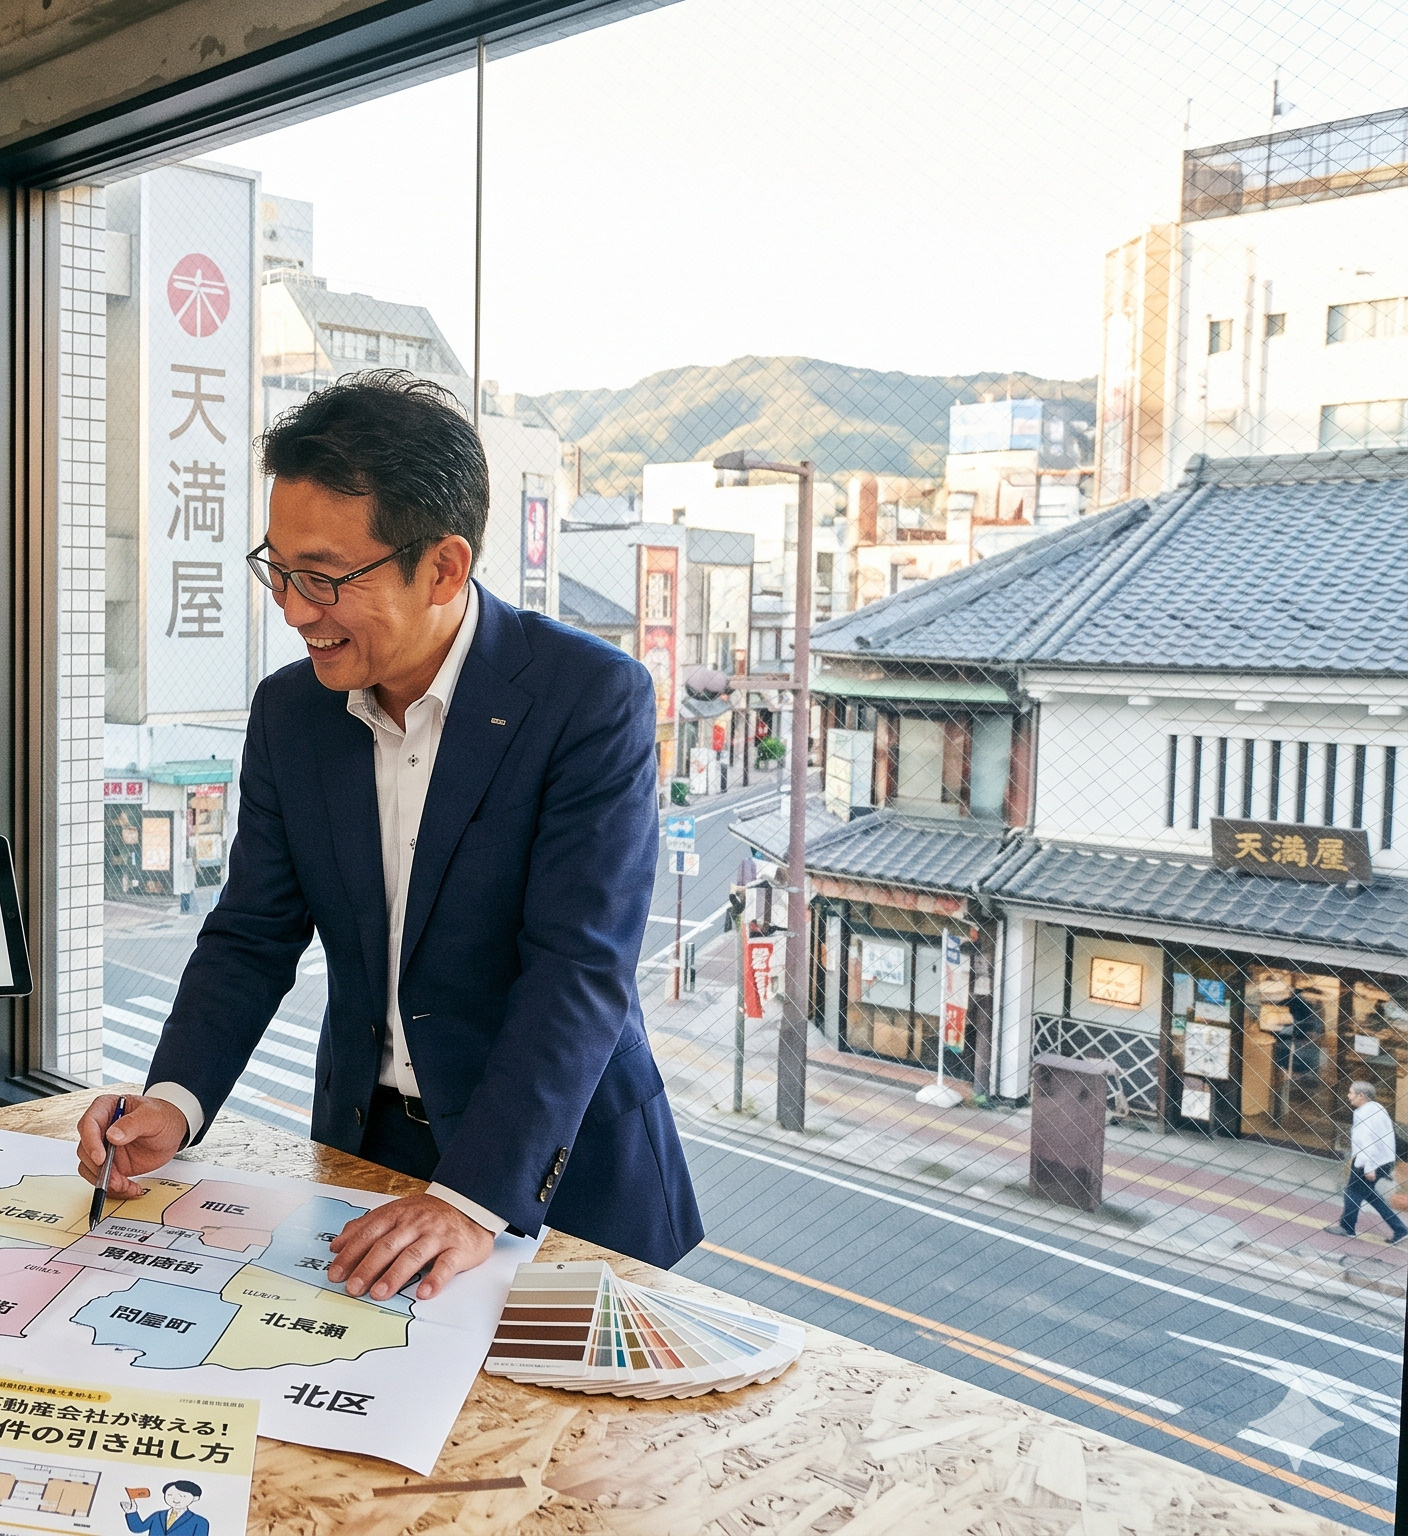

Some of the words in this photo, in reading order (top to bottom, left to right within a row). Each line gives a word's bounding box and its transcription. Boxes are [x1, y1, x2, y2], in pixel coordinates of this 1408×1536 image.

[165, 363, 228, 639] 天満屋
[1234, 832, 1349, 872] 天満屋
[109, 1305, 197, 1334] 問屋町
[259, 1311, 350, 1340] 北長瀬
[283, 1382, 376, 1417] 北区
